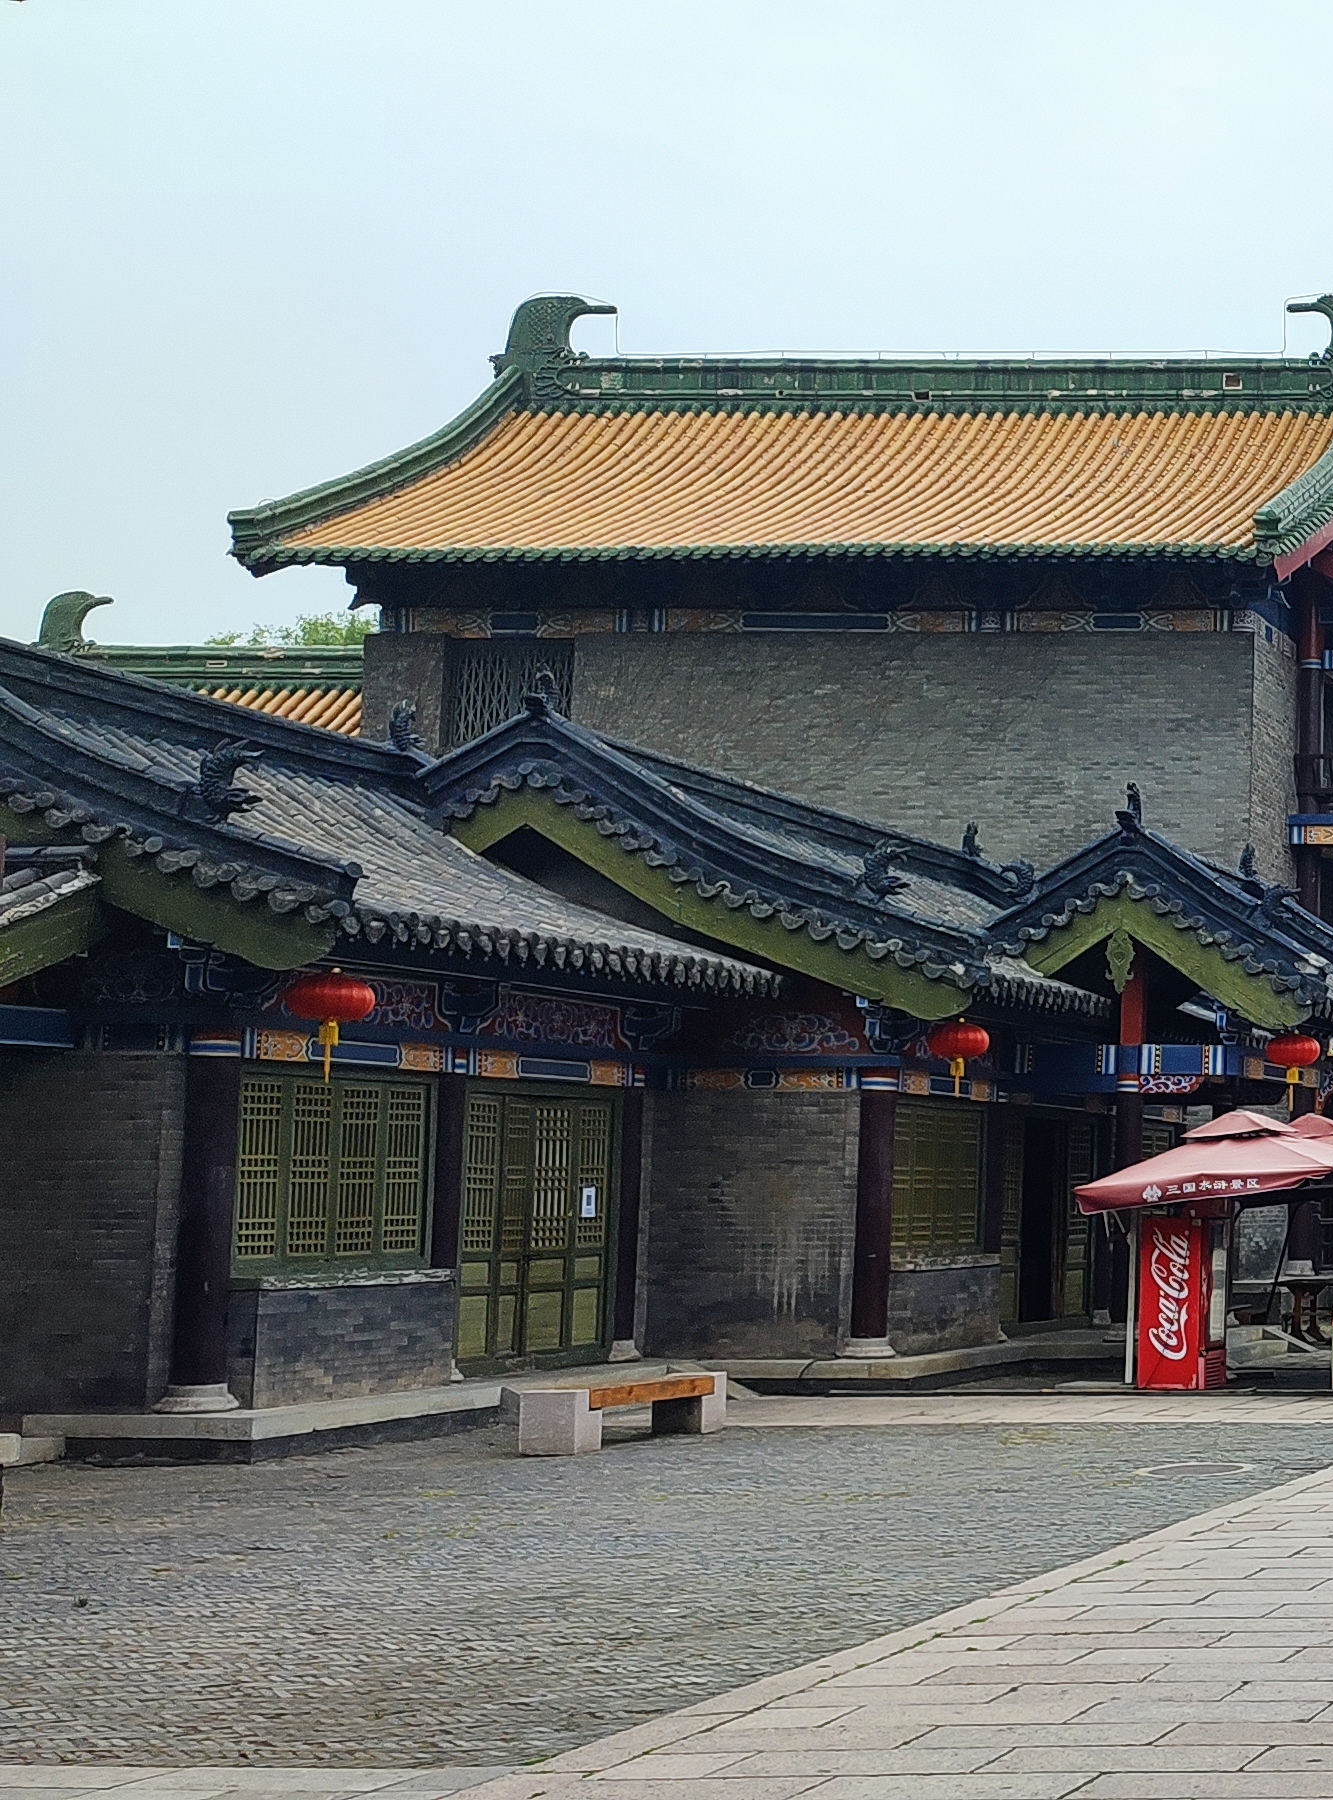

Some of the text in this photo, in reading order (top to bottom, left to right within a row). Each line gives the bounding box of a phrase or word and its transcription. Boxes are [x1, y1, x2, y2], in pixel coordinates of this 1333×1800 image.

[1166, 1178, 1260, 1195] 三国水浒景区
